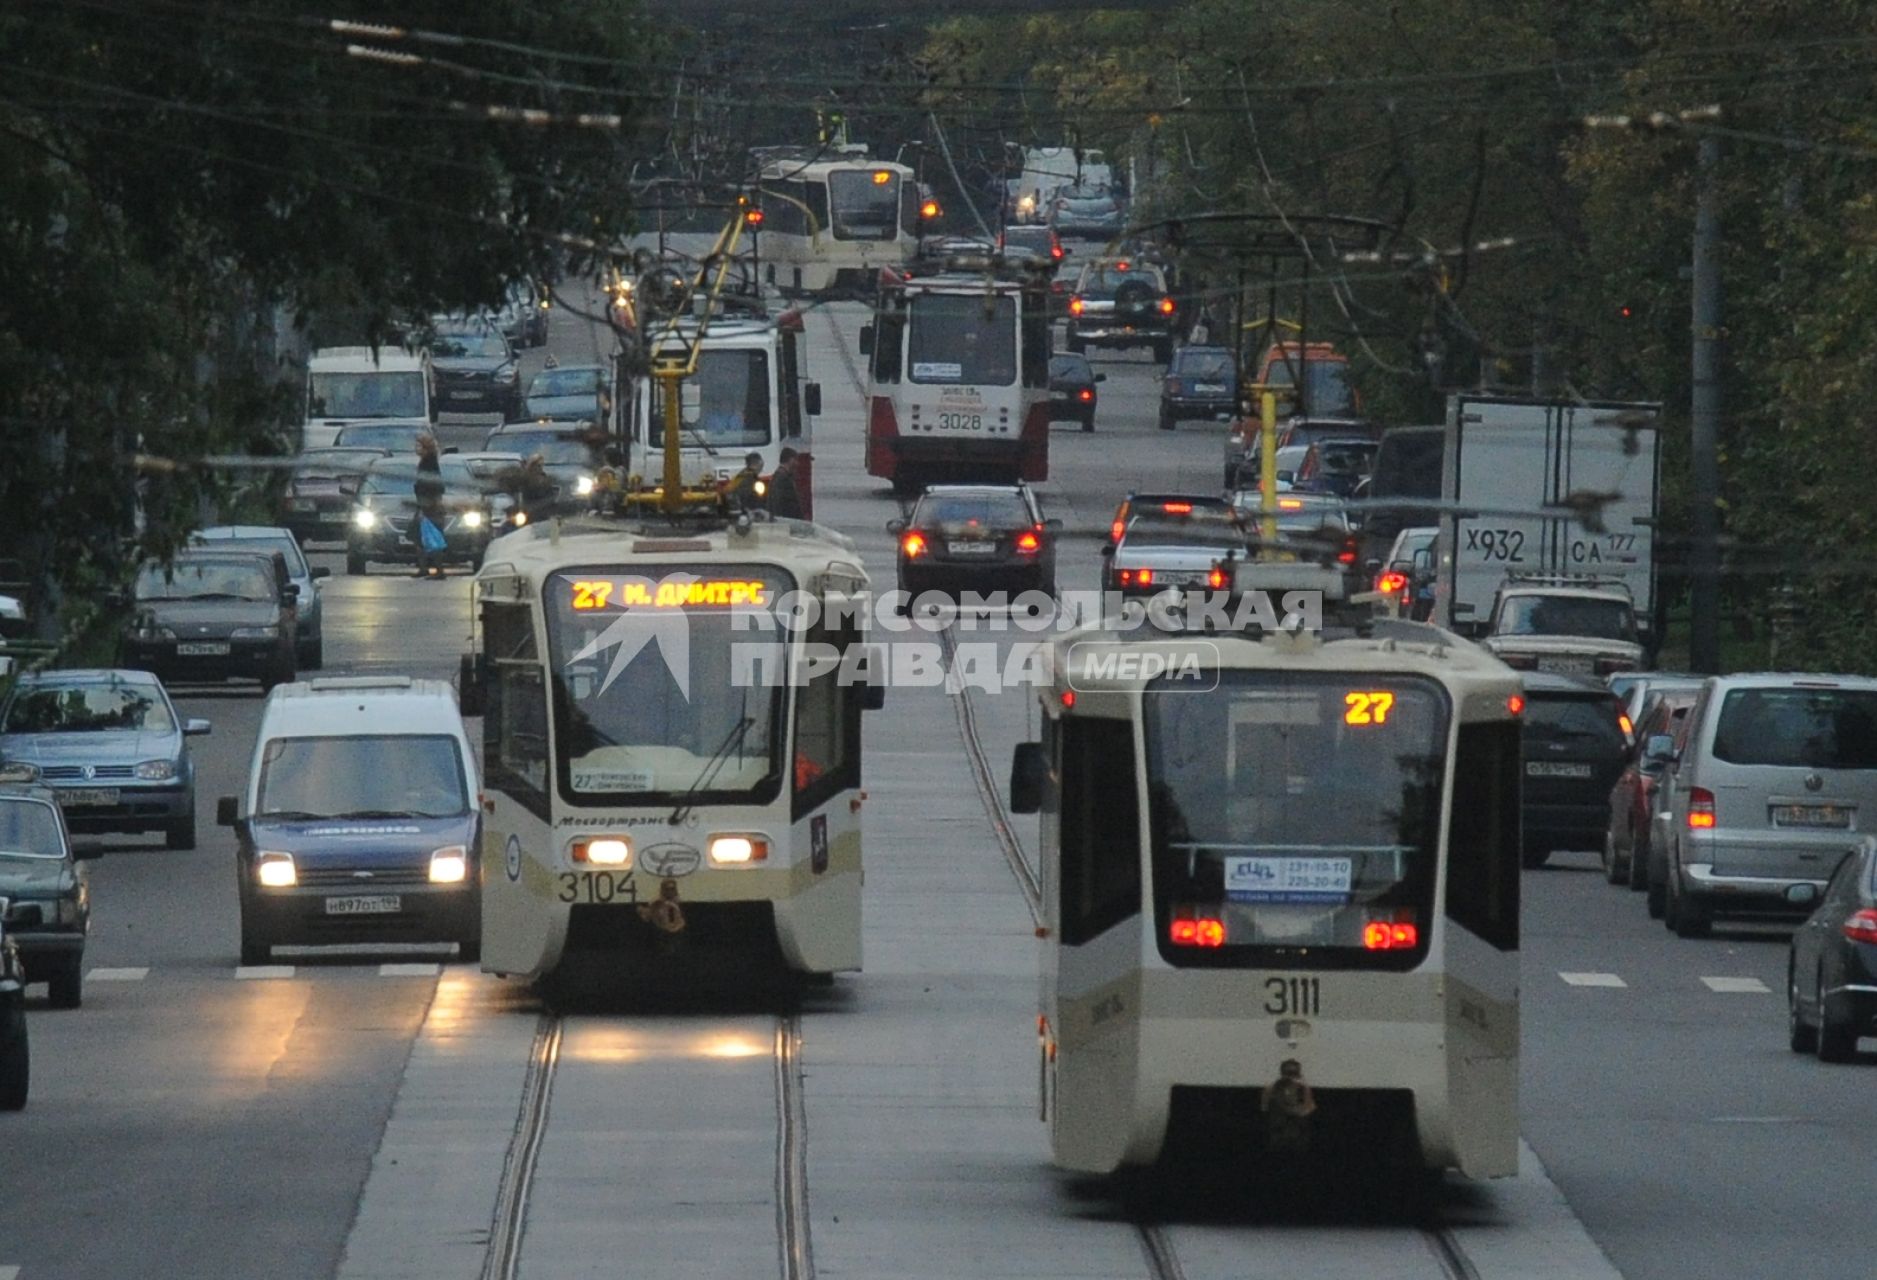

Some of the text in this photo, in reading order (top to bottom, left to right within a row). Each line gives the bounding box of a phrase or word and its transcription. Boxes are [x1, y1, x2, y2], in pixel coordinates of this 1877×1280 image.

[939, 413, 982, 430] 3028
[1466, 528, 1636, 563] Х932 СА 177
[572, 580, 614, 610] 27
[1344, 692, 1394, 725] 27
[558, 871, 638, 904] 3104
[1264, 977, 1320, 1015] 3111
